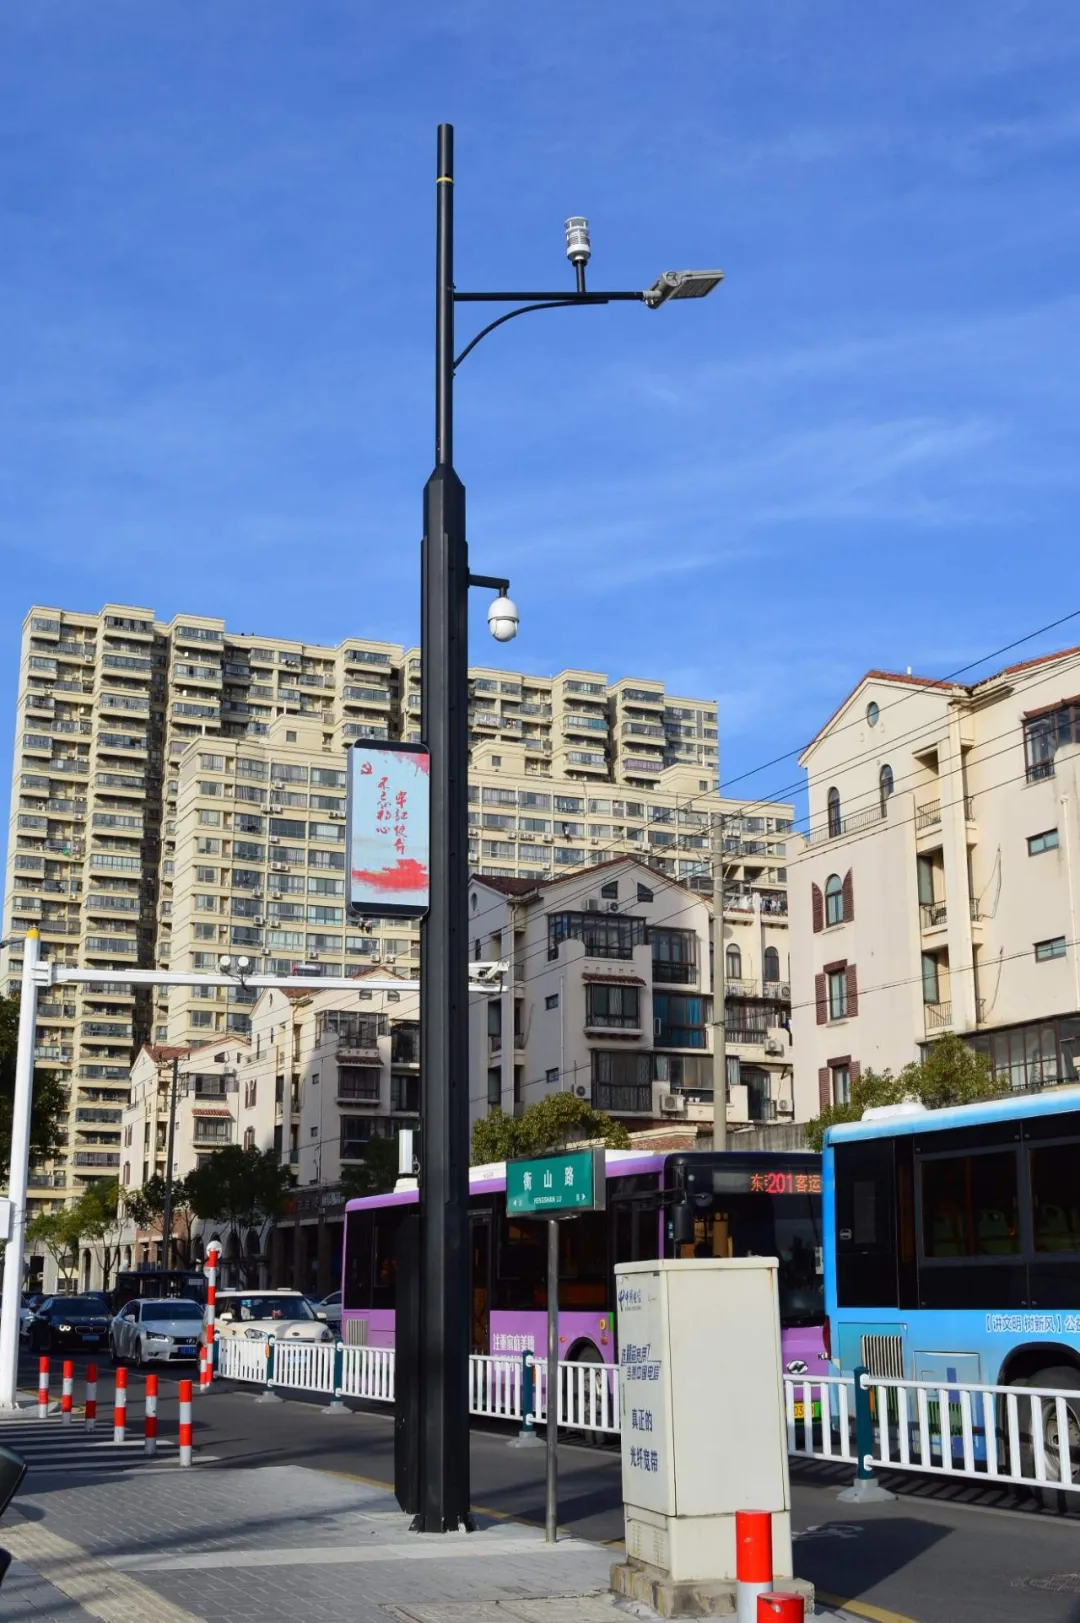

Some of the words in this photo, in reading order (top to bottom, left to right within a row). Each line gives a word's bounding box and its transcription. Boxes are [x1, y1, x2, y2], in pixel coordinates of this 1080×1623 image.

[523, 1165, 574, 1191] 衡山路
[767, 1173, 793, 1194] 201
[632, 1409, 652, 1432] 真正的
[630, 1446, 658, 1473] 光纤宽带
